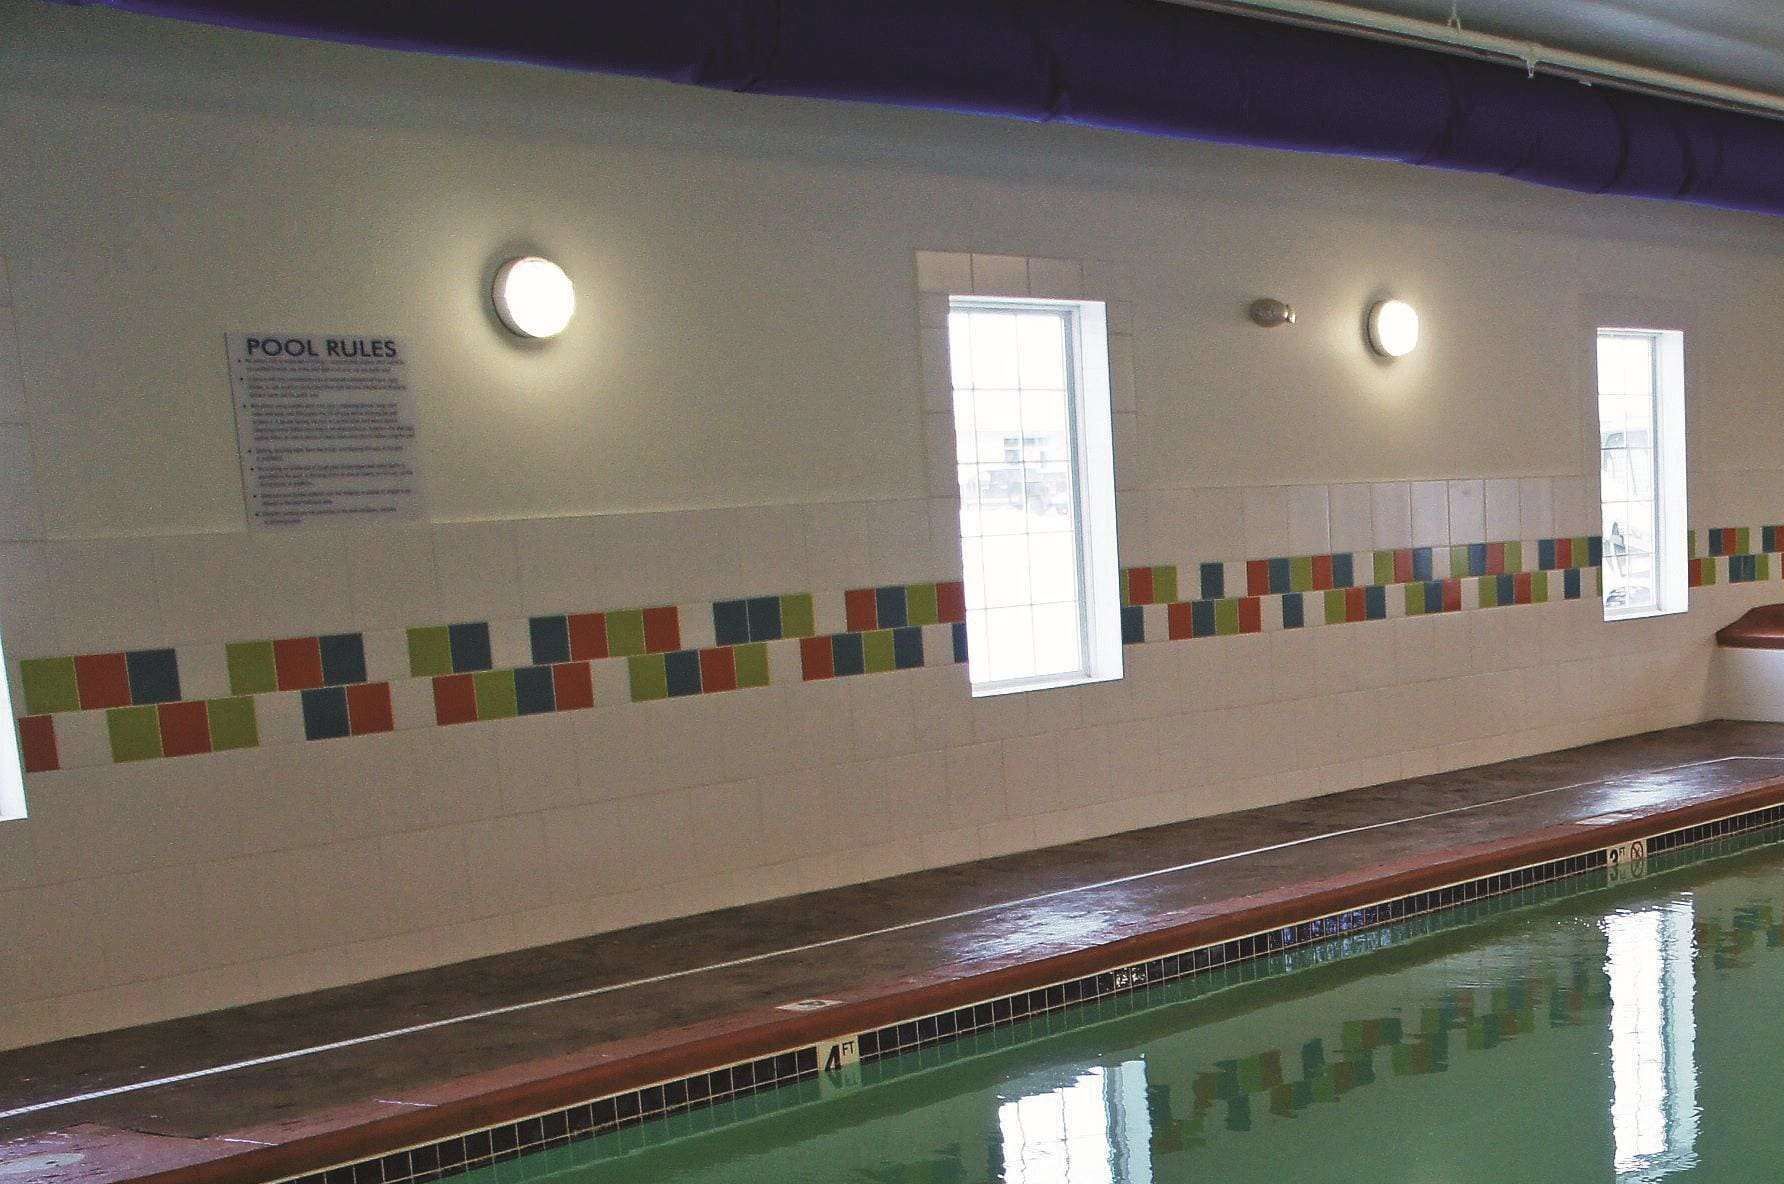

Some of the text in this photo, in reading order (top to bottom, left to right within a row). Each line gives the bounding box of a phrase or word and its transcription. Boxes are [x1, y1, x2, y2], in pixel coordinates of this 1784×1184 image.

[247, 338, 397, 358] POOL RULES
[843, 1041, 854, 1055] FT
